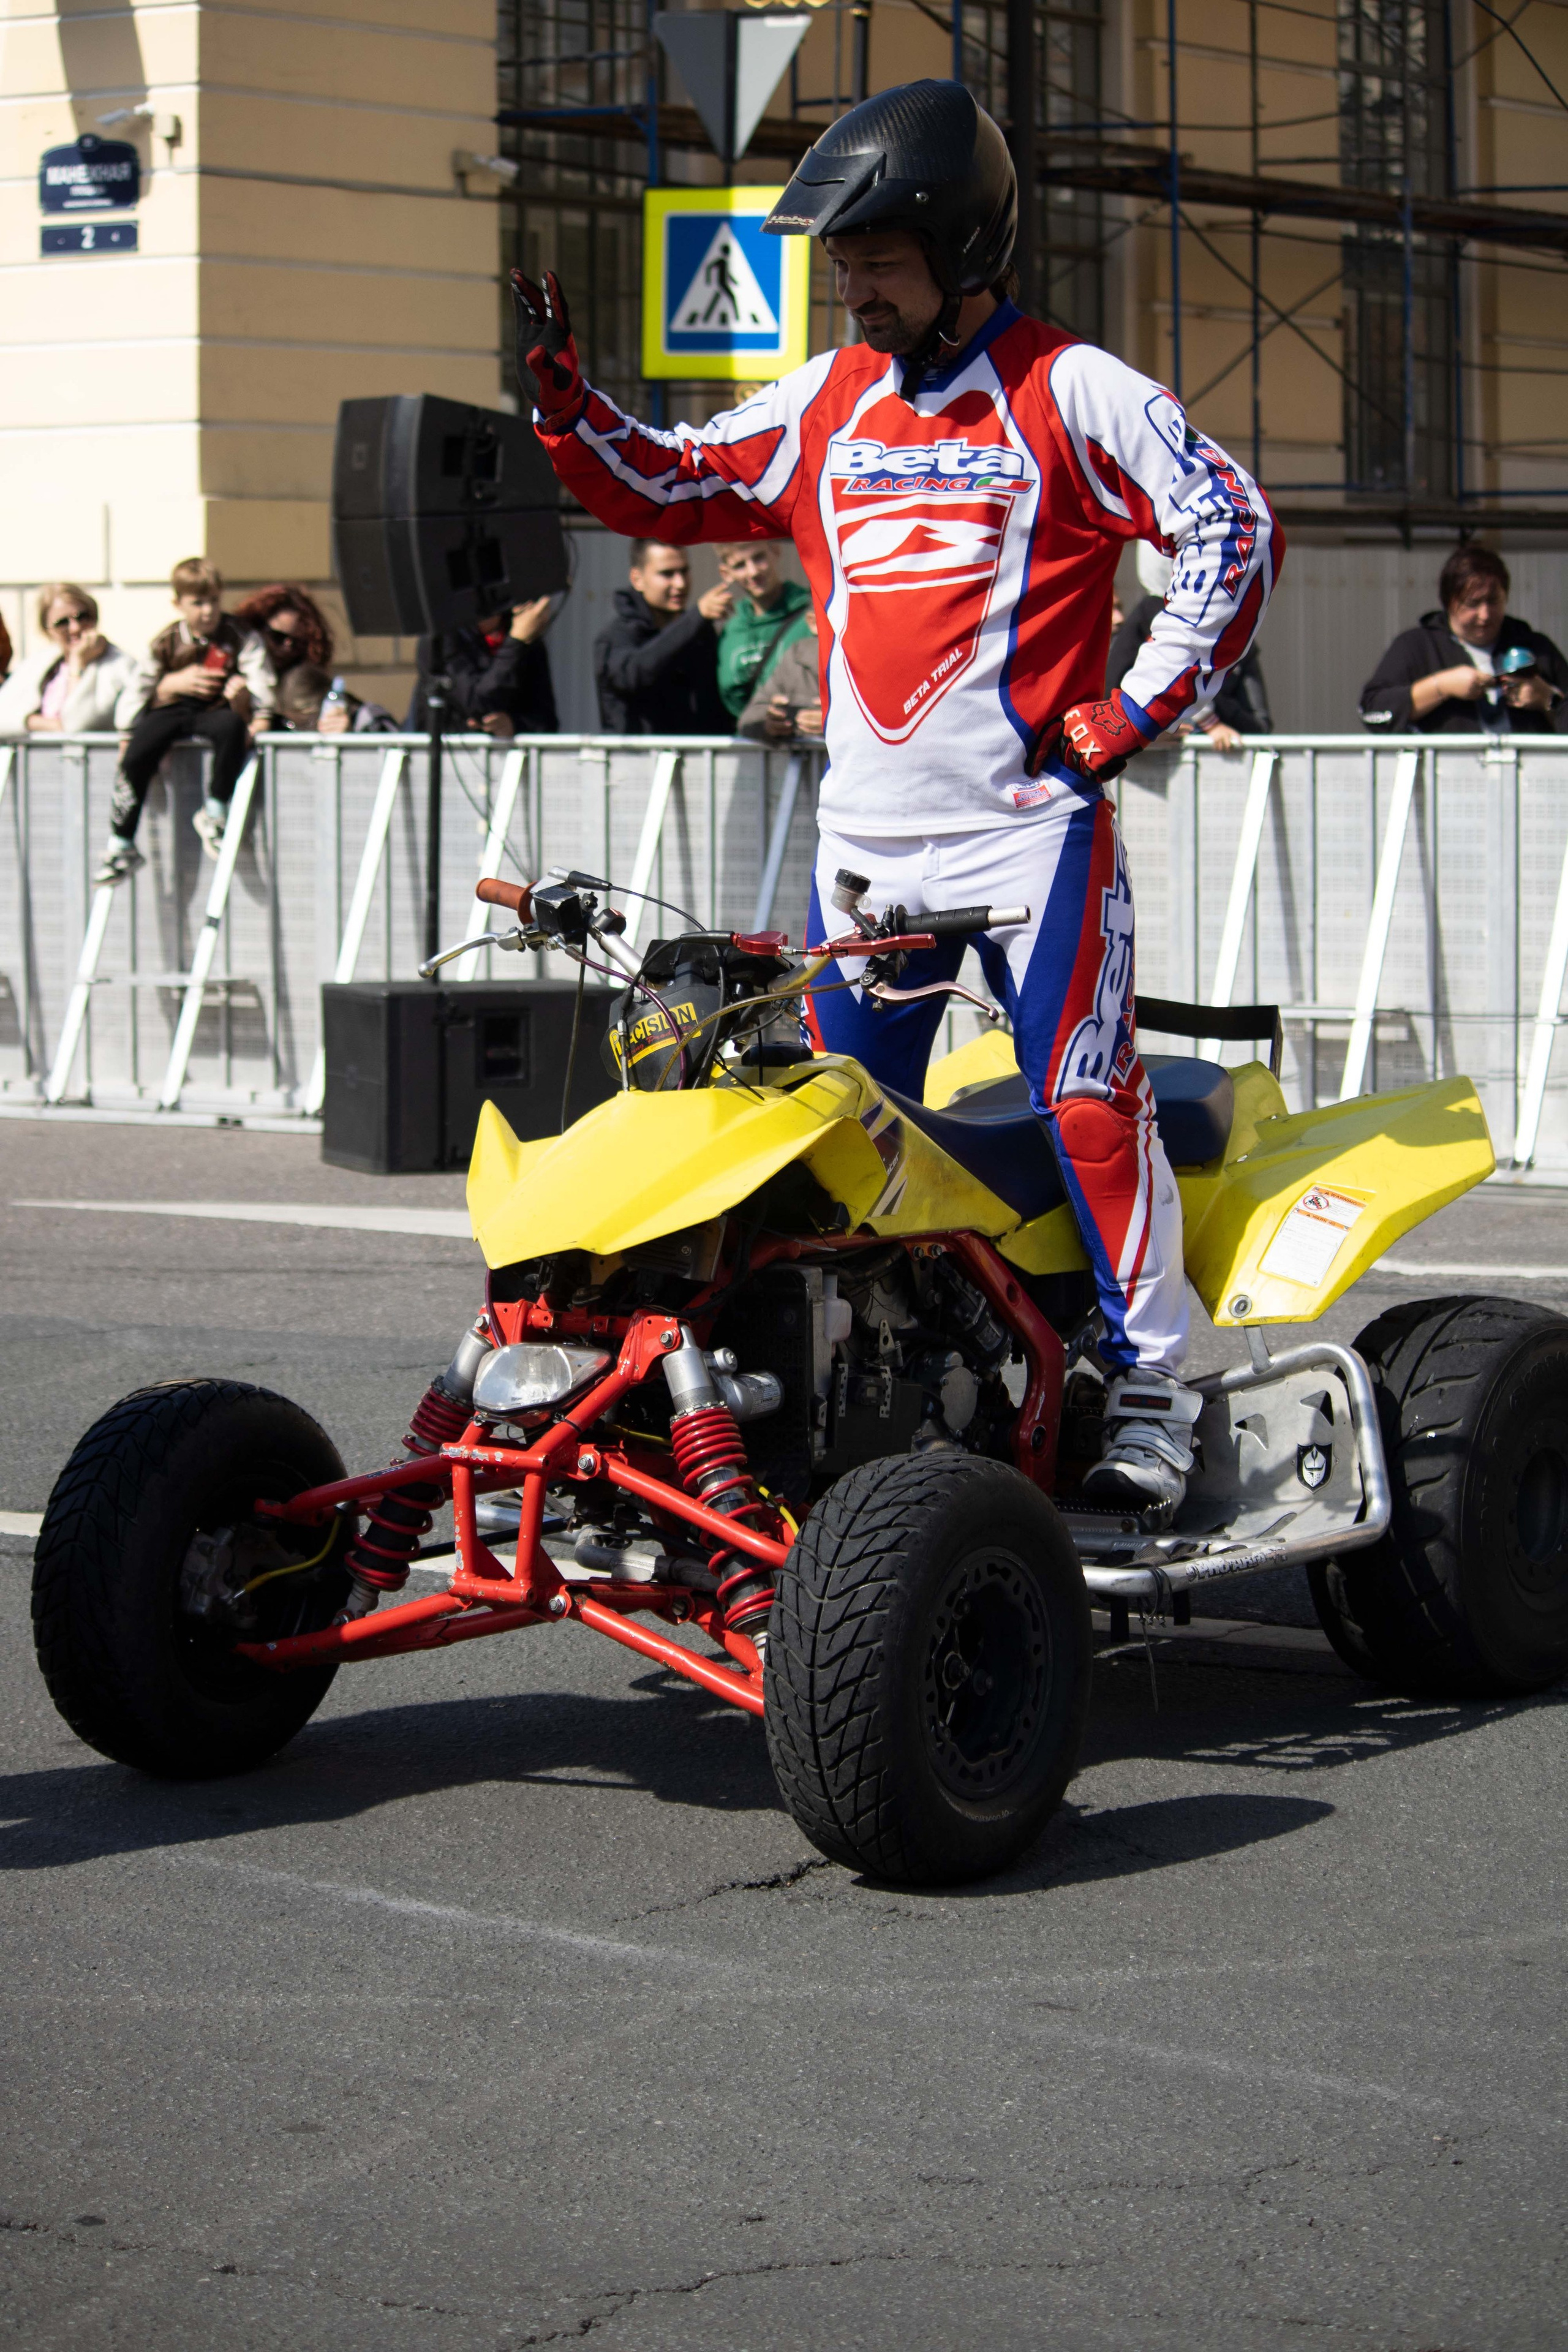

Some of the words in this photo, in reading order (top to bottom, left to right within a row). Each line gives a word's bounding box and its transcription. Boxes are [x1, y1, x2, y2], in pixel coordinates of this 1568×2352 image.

[80, 225, 95, 249] 2
[830, 440, 1023, 476] Beta
[851, 476, 971, 491] RACING
[1195, 448, 1256, 598] RACING
[903, 679, 931, 715] BETA
[930, 647, 963, 682] TRIAL
[1063, 709, 1101, 761] FOX
[611, 1005, 697, 1058] PCISION
[1330, 1193, 1357, 1205] WARNING
